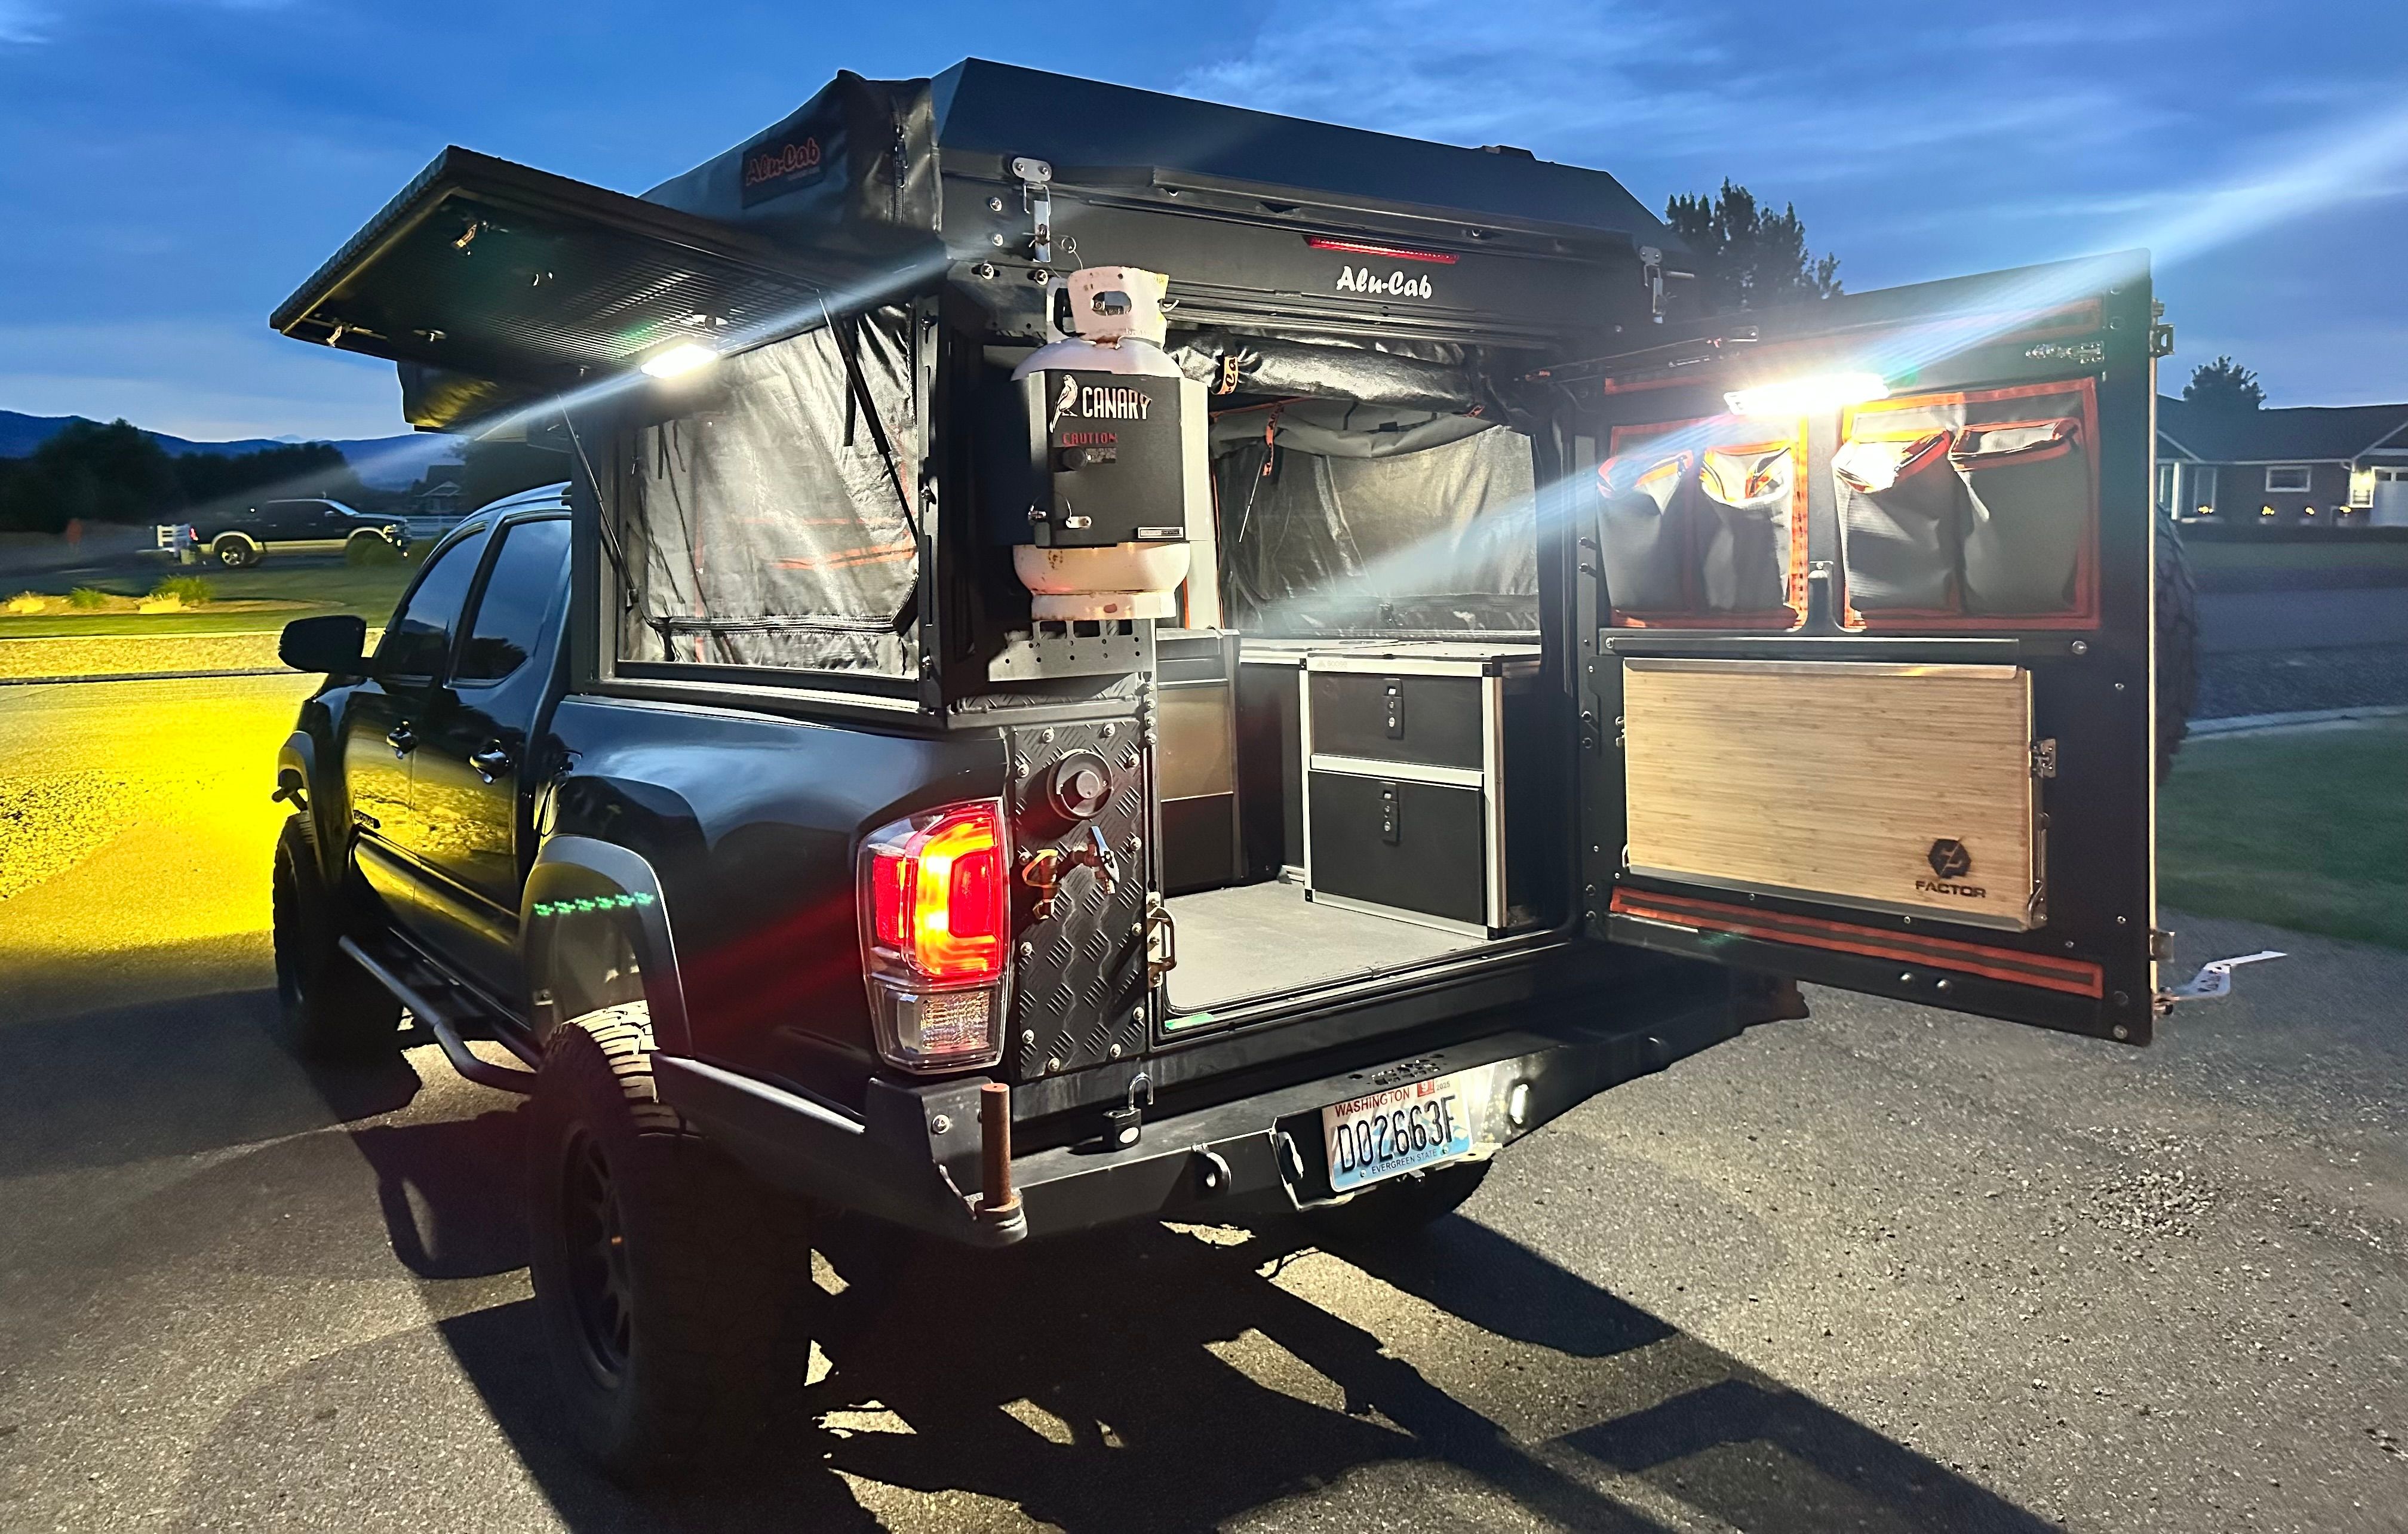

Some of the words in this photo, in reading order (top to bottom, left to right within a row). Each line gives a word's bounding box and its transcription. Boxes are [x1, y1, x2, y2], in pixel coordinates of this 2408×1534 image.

[1336, 265, 1432, 299] Alu-Cab
[1082, 386, 1153, 420] CANARY
[1062, 432, 1118, 445] CAUTION
[1915, 880, 1986, 899] FACTOR
[1436, 1081, 1451, 1090] 2025
[1335, 1087, 1410, 1117] WASHINGTON
[1371, 1155, 1415, 1175] EVERGREEN
[1417, 1149, 1438, 1162] STATE
